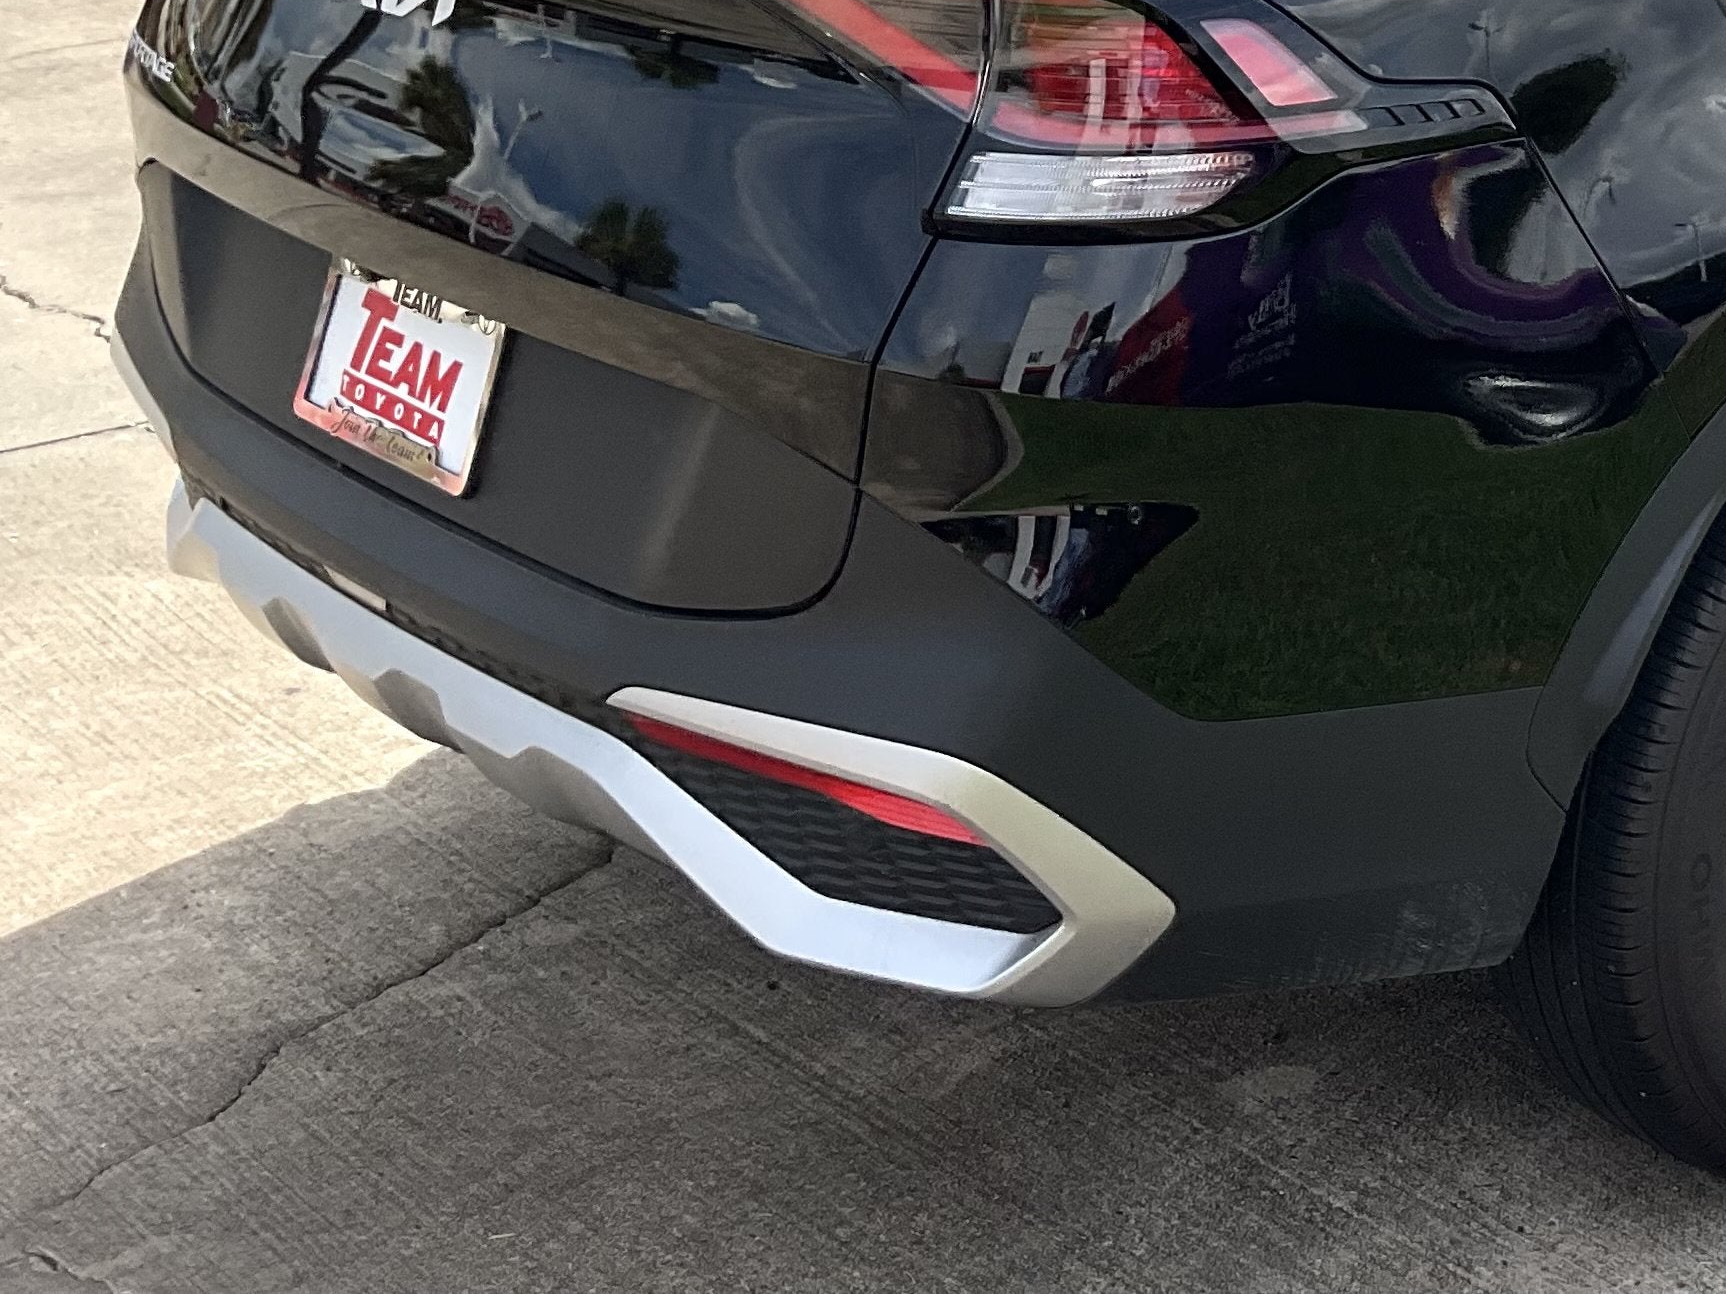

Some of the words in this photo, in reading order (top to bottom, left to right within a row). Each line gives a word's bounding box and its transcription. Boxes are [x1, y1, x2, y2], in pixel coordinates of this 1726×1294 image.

[392, 279, 442, 322] TEAM
[350, 287, 464, 414] TEAM
[341, 373, 441, 440] TOYOTA
